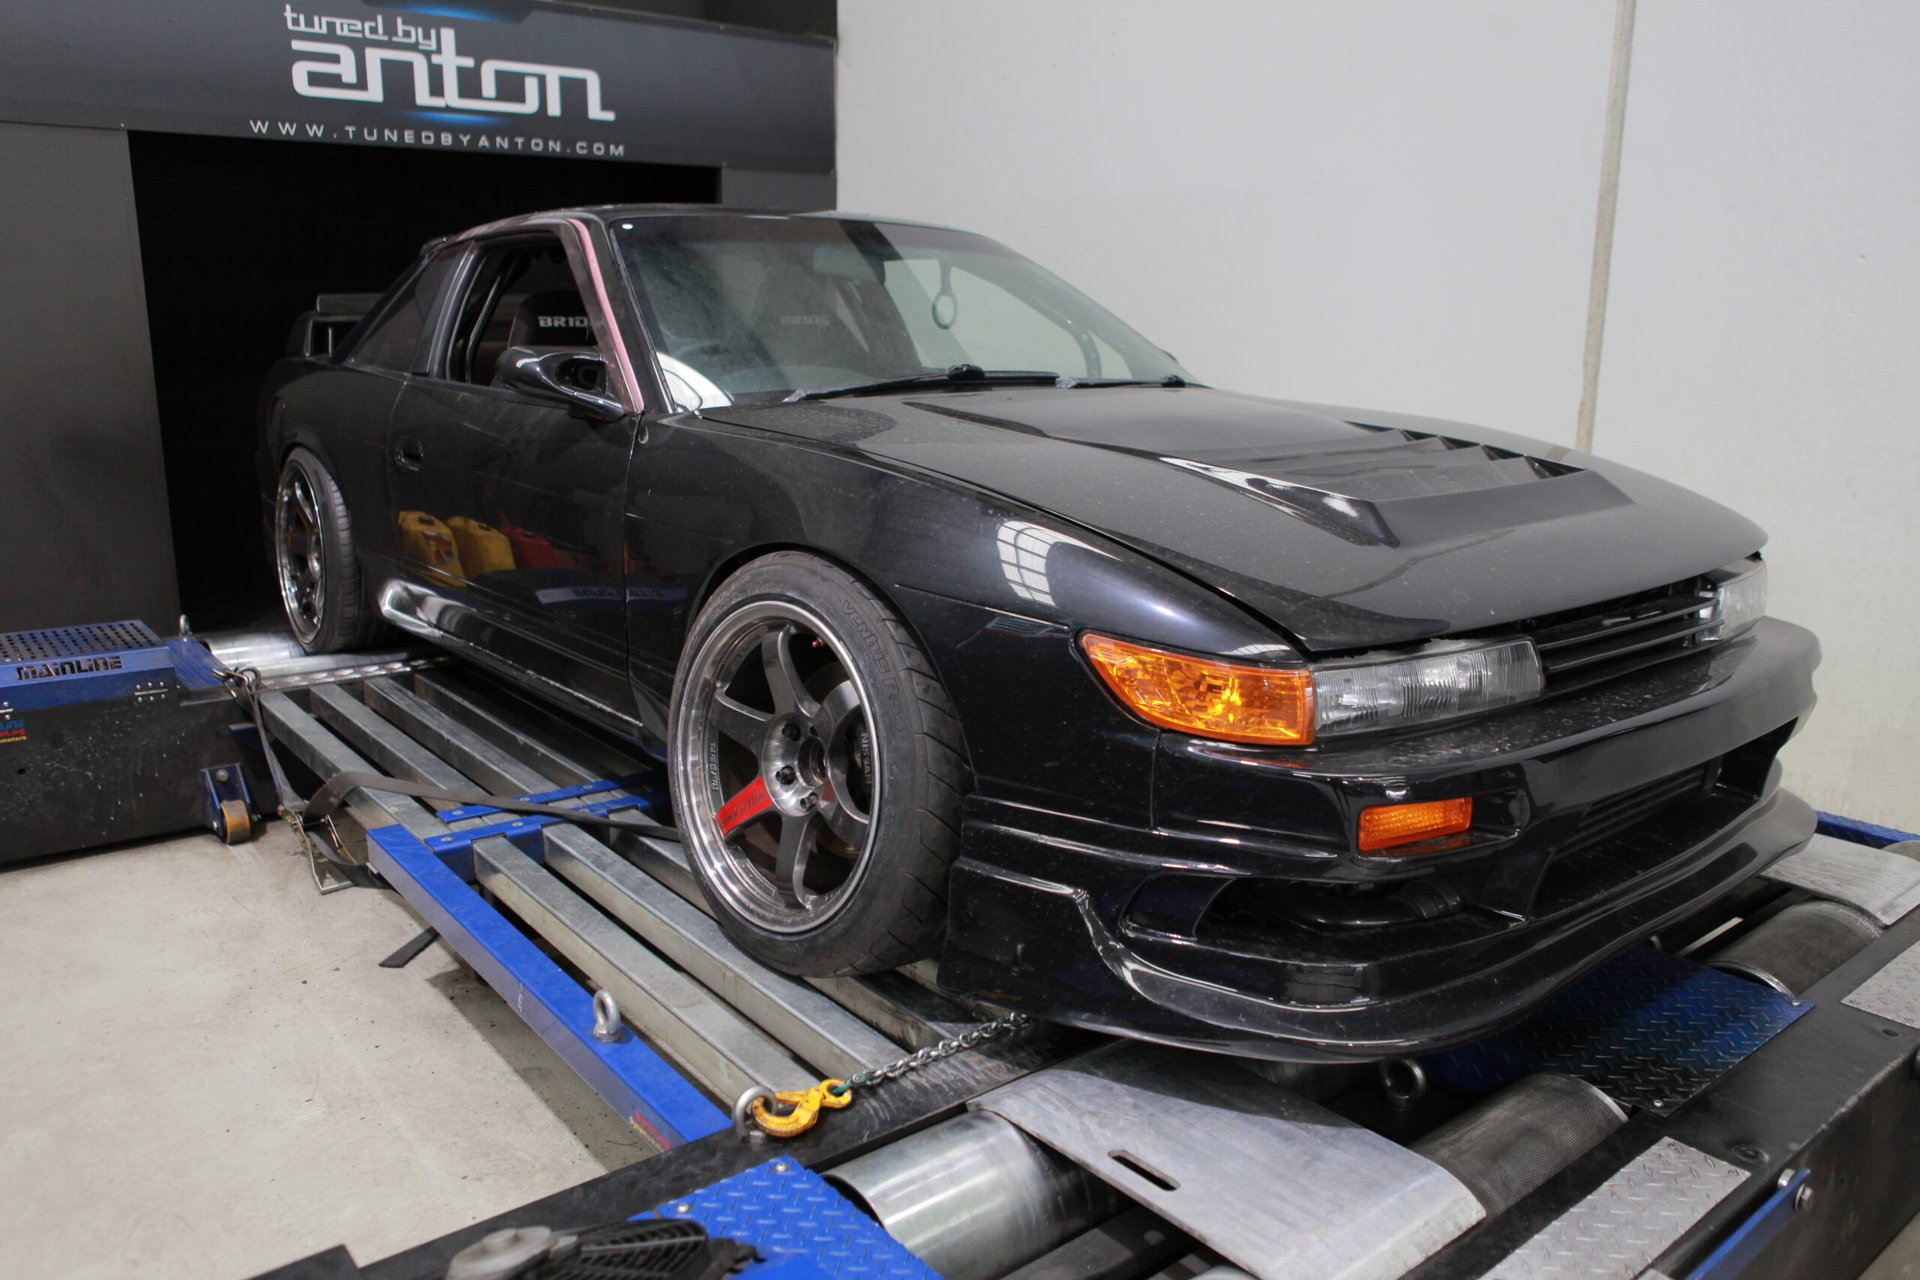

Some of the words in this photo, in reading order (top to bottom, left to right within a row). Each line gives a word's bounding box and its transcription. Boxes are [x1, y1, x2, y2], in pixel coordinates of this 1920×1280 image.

[283, 3, 389, 41] tuned
[392, 16, 437, 51] by
[290, 27, 616, 122] anton
[249, 118, 626, 158] WWW.TUNEDBYANTON.COM
[537, 315, 592, 328] BRID
